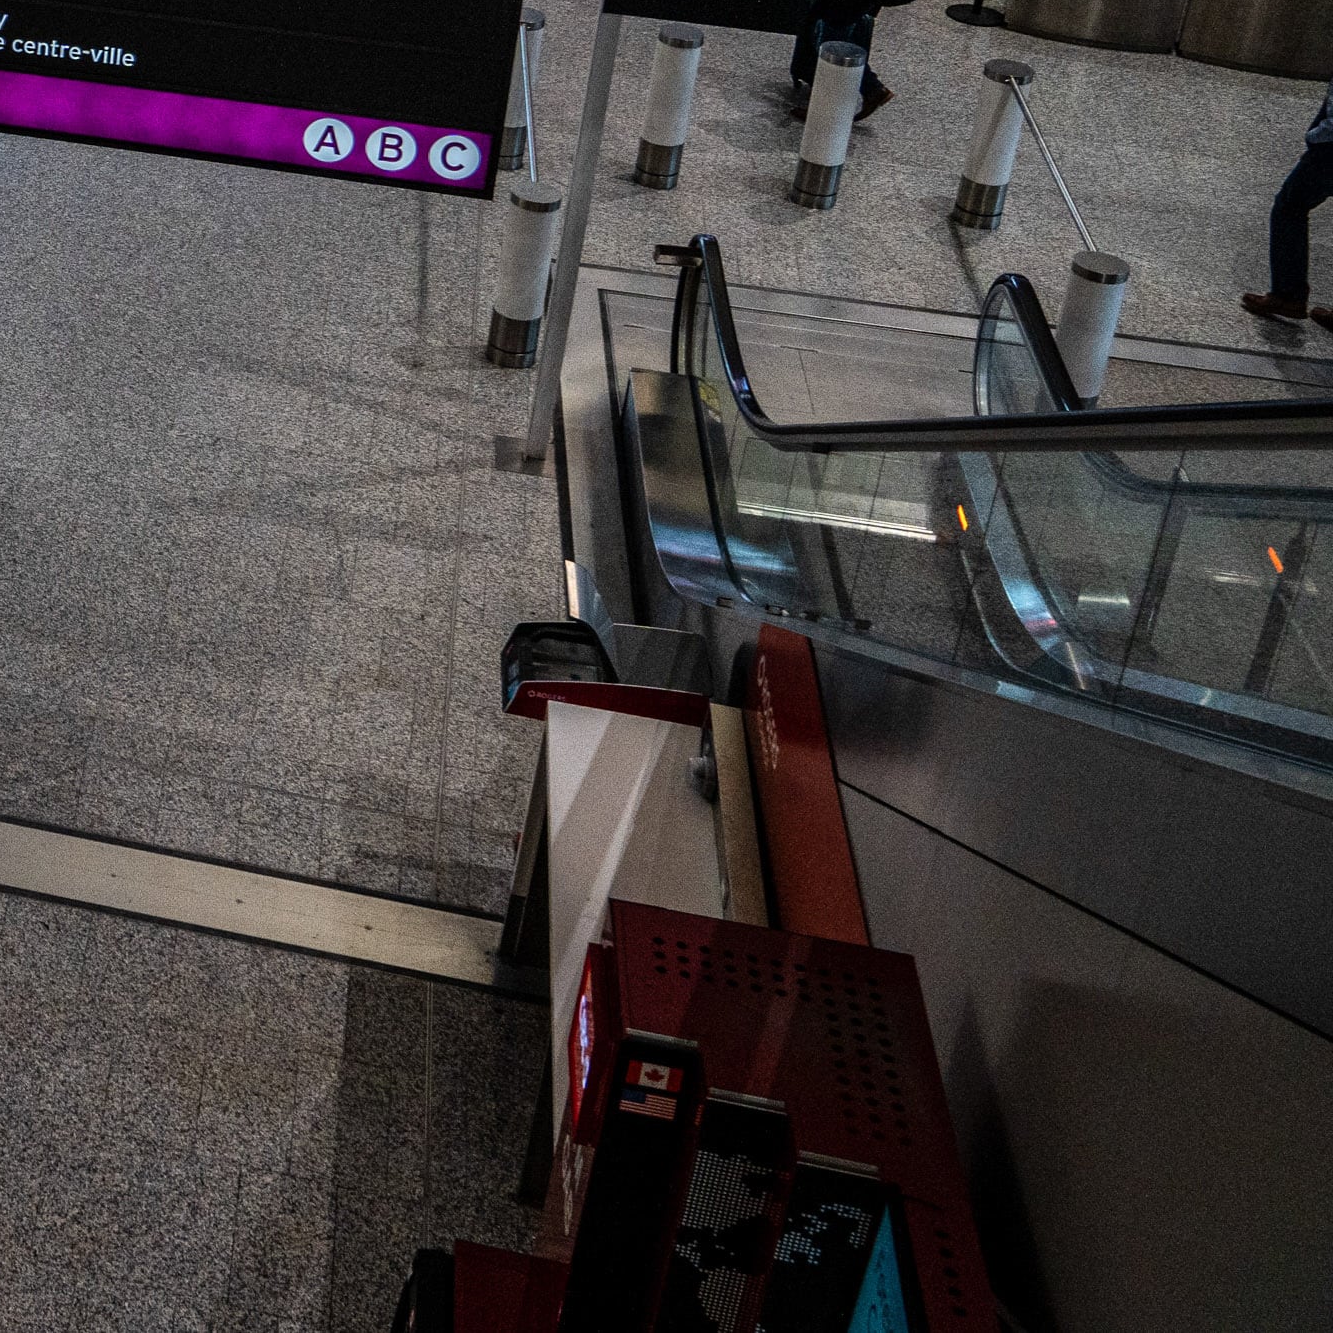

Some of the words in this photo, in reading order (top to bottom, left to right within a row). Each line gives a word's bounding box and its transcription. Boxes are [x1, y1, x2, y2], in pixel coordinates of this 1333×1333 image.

[12, 37, 135, 67] centre-ville
[313, 126, 341, 155] A
[378, 133, 404, 163] B
[440, 141, 468, 172] C
